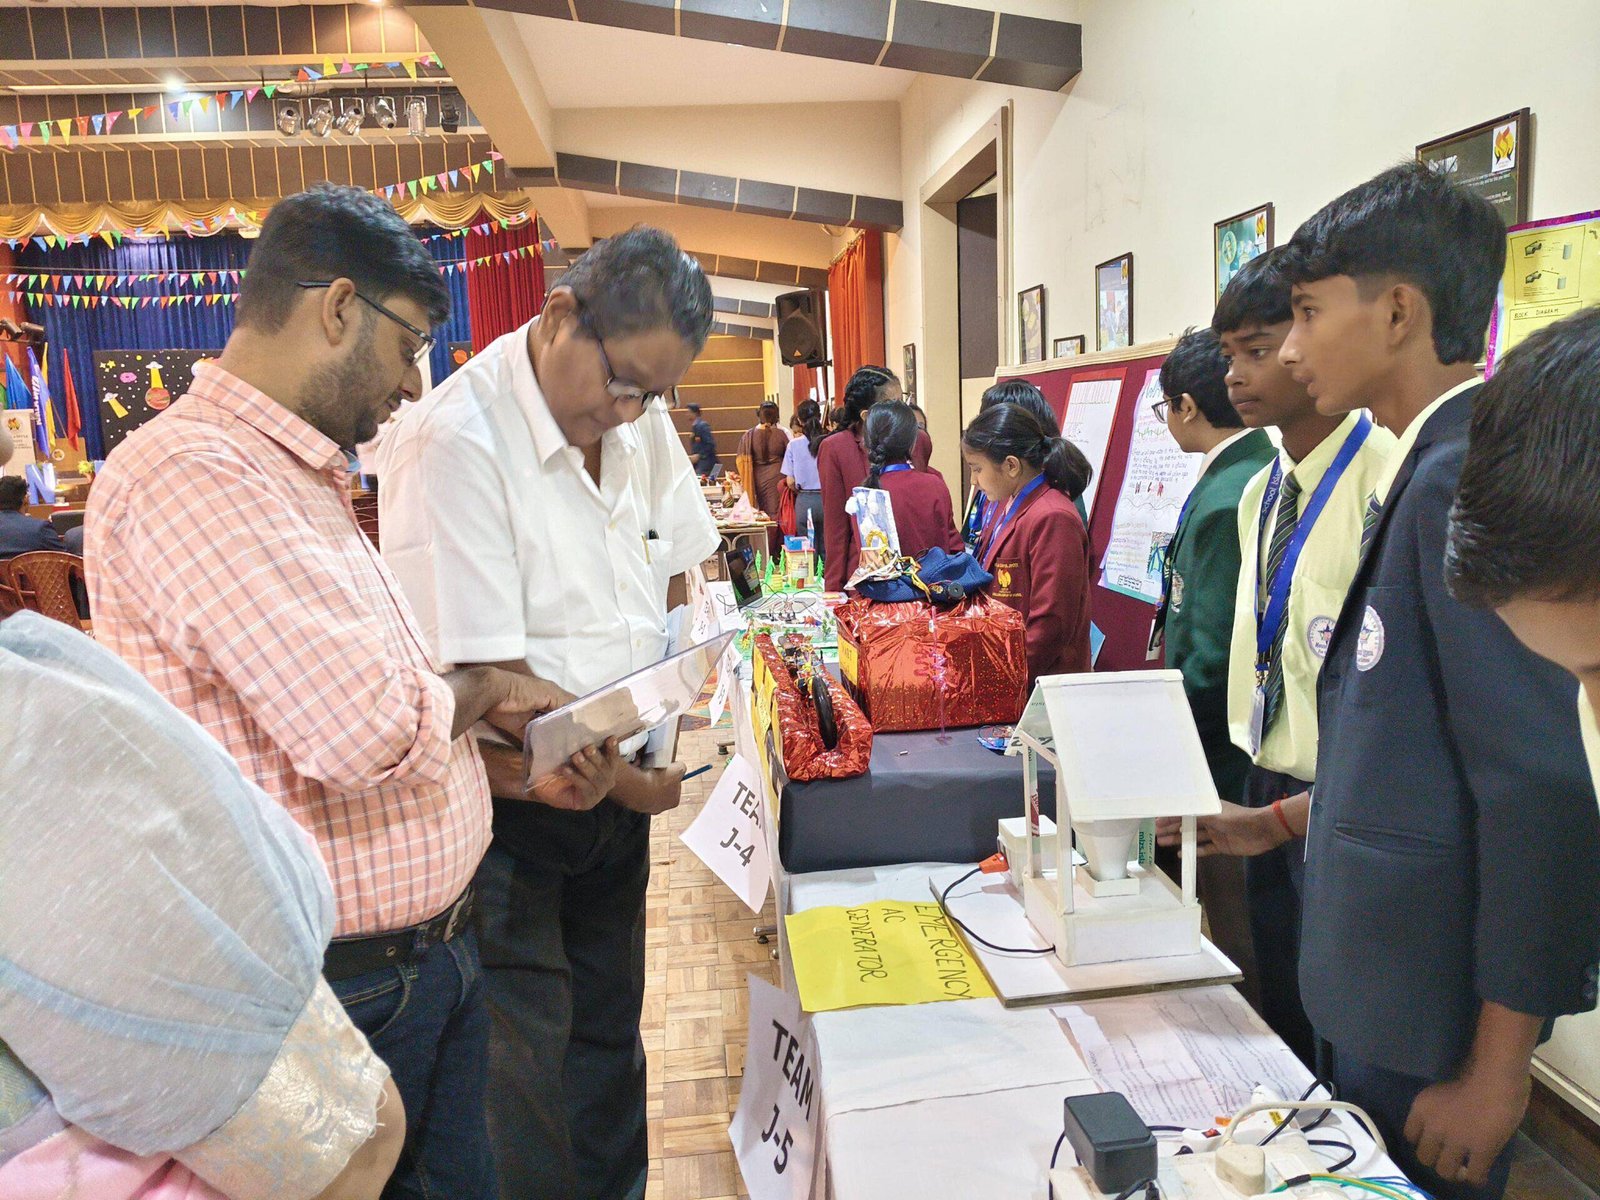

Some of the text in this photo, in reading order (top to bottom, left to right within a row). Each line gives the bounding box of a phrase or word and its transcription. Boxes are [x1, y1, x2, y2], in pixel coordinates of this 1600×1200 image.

[732, 781, 762, 829] TEA
[720, 827, 755, 867] J-4
[846, 908, 888, 983] GENERATOR
[881, 908, 906, 923] AC
[914, 905, 976, 999] EMERGENCY
[773, 1019, 814, 1122] TEAM
[761, 1103, 794, 1175] J-5
